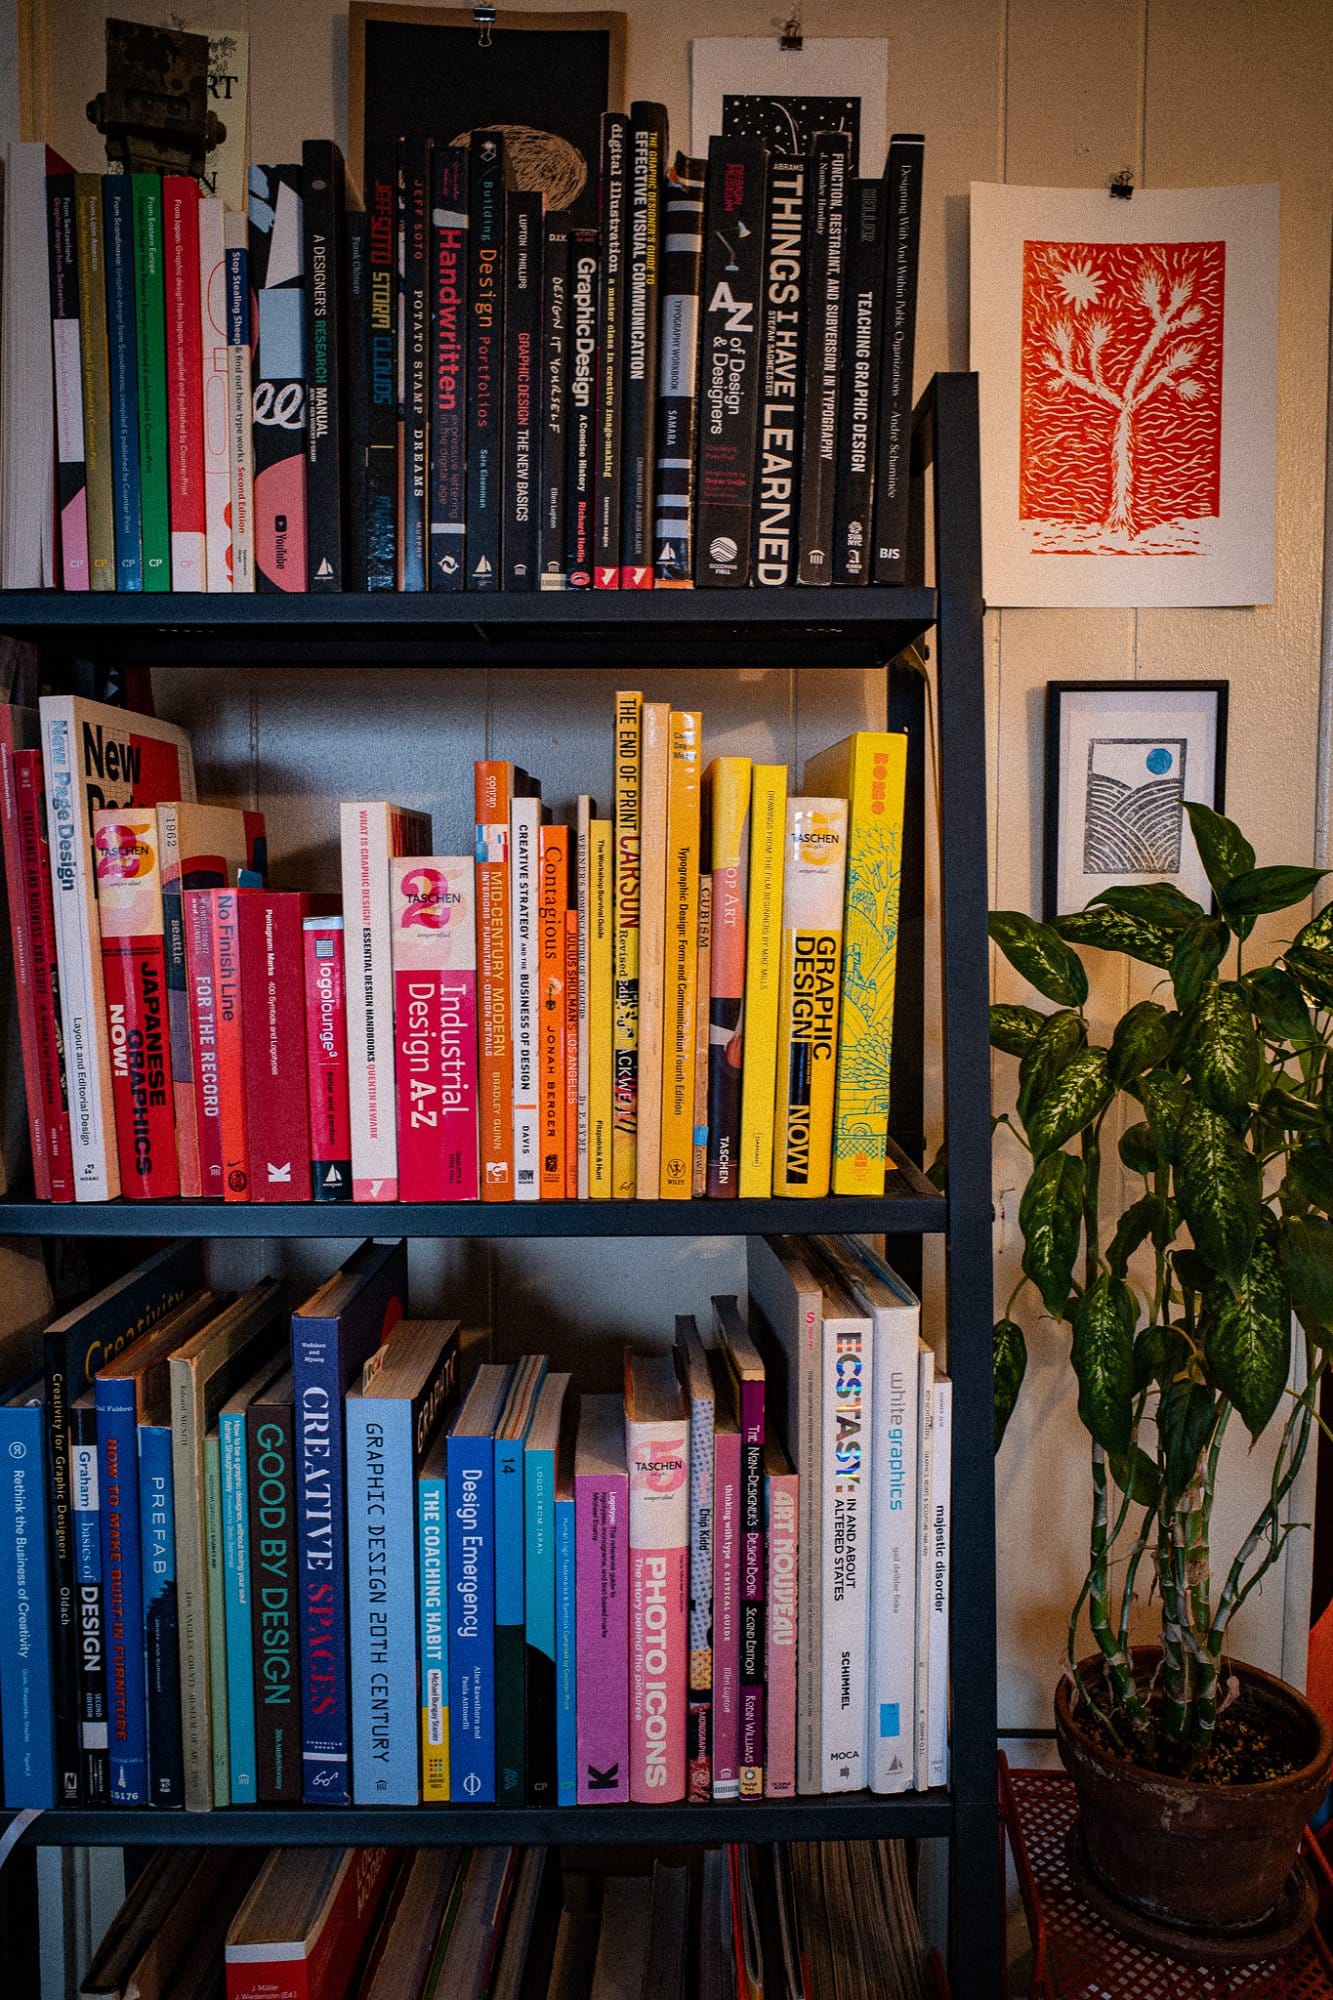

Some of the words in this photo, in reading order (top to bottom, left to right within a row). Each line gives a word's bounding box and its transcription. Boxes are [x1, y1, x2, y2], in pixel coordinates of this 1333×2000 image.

[634, 131, 648, 206] EFFECTIVE
[828, 153, 844, 210] FUNCTION,
[479, 181, 494, 241] Building
[633, 209, 646, 259] VISUAL
[229, 251, 240, 271] Stop
[313, 234, 325, 244] A
[768, 174, 803, 304] THINGS
[826, 213, 842, 274] RESTRAINT,
[230, 273, 241, 311] Stealing
[474, 248, 497, 328] Design
[826, 278, 840, 300] AND
[231, 312, 242, 345] Sheep
[414, 290, 423, 354] POTATO
[438, 229, 462, 410] Handwritten
[631, 262, 646, 380] COMMUNICATION
[777, 310, 795, 322] I
[824, 304, 839, 371] SUBVERSION
[855, 291, 872, 358] TEACHING
[235, 355, 244, 372] find
[314, 320, 327, 384] RESEARCH
[517, 332, 530, 384] GRAPHIC
[774, 330, 794, 397] HAVE
[236, 374, 244, 388] out
[236, 390, 245, 409] how
[414, 361, 423, 415] STAMP
[477, 336, 492, 428] Portfolios
[823, 375, 836, 386] IN
[853, 362, 870, 419] GRAPHIC
[235, 411, 245, 431] type
[315, 387, 328, 438] MANUAL
[517, 387, 530, 425] DESIGN
[820, 390, 836, 460] TYPOGRAPHY
[237, 433, 246, 463] works
[414, 429, 423, 498] DREAMS
[517, 430, 529, 452] THE
[578, 423, 587, 455] Concise
[851, 423, 868, 472] DESIGN
[238, 467, 246, 499] Second
[516, 455, 529, 480] NEW
[576, 457, 587, 492] History
[238, 501, 247, 533] Edition
[516, 482, 529, 521] BASICS
[578, 501, 587, 533] Richard
[757, 404, 795, 585] LEARNED
[275, 534, 287, 570] YouTube
[577, 535, 586, 563] Hollis
[879, 548, 900, 559] BIS
[619, 698, 637, 725] THE
[51, 720, 70, 768] New
[84, 722, 142, 785] New
[619, 730, 637, 760] END
[50, 771, 73, 820] Page
[619, 764, 637, 782] OF
[166, 817, 178, 847] 1962
[619, 790, 637, 832] PRINT
[53, 825, 78, 891] Design
[519, 824, 530, 877] CREATIVE
[675, 846, 689, 900] Typographic
[218, 895, 233, 921] No
[406, 894, 461, 903] TASCHEN
[520, 882, 530, 940] STRATEGY
[541, 846, 561, 959] Contagious
[699, 887, 711, 948] CUBISM
[171, 919, 185, 964] seattle
[491, 871, 505, 980] MID-CENTURY
[677, 939, 688, 961] Form
[219, 925, 235, 978] Finish
[677, 963, 687, 980] and
[196, 976, 213, 1009] FOR
[221, 984, 237, 1021] Line
[520, 973, 531, 1029] BUSINESS
[791, 936, 814, 1040] DESIGN
[814, 936, 835, 1060] GRAPHIC
[71, 1017, 85, 1048] Layout
[109, 1004, 129, 1077] NOW!
[141, 961, 166, 1106] JAPANESE
[198, 1014, 215, 1046] THE
[402, 982, 436, 1072] Design
[492, 988, 506, 1057] MODERN
[521, 1031, 531, 1046] OF
[675, 983, 687, 1052] Communication
[76, 1051, 86, 1069] and
[441, 984, 469, 1115] Industrial
[521, 1049, 531, 1091] DESIGN
[547, 1025, 556, 1075] JONAH
[675, 1054, 686, 1082] Fourth
[77, 1072, 89, 1112] Editorial
[128, 1030, 151, 1175] GRAPHICS
[200, 1052, 219, 1117] RECORD
[410, 1079, 437, 1128] A-Z
[674, 1084, 685, 1116] Edition
[78, 1113, 92, 1146] Design
[547, 1082, 556, 1137] BERGER
[522, 1125, 530, 1154] DAVIS
[719, 1136, 729, 1184] TASCHEN
[787, 1104, 810, 1175] NOW
[13, 1470, 27, 1510] Rethink
[79, 1451, 93, 1507] Graham
[257, 1423, 286, 1528] GOOD
[301, 1387, 333, 1570] CREATIVE
[366, 1423, 384, 1515] GRAPHIC
[502, 1458, 515, 1474] 14
[635, 1461, 682, 1471] TASCHEN
[423, 1490, 440, 1521] THE
[457, 1469, 482, 1529] Design
[697, 1508, 710, 1527] Chip
[722, 1484, 733, 1520] thinking
[845, 1498, 856, 1509] IN
[15, 1514, 27, 1534] the
[81, 1522, 96, 1563] basics
[151, 1477, 167, 1574] PREFAB
[699, 1529, 710, 1551] Kidd
[724, 1522, 733, 1539] with
[834, 1499, 845, 1554] ALTERED
[845, 1513, 856, 1539] AND
[932, 1505, 946, 1557] majestic
[16, 1537, 29, 1586] Business
[83, 1566, 97, 1582] of
[260, 1540, 287, 1577] BY
[368, 1525, 386, 1603] DESIGN
[423, 1525, 441, 1609] COACHING
[722, 1541, 733, 1560] type
[845, 1541, 856, 1589] ABOUT
[18, 1588, 30, 1600] of
[457, 1536, 482, 1637] Emergency
[834, 1558, 845, 1602] STATES
[934, 1561, 946, 1613] disorder
[15, 1603, 32, 1658] Creativity
[81, 1586, 102, 1671] DESIGN
[369, 1612, 387, 1663] 20TH
[425, 1613, 442, 1660] HABIT
[645, 1557, 667, 1674] PHOTO
[261, 1587, 290, 1704] DESIGN
[306, 1583, 337, 1715] SPACES
[841, 1651, 850, 1710] SCHIMMEL
[370, 1672, 389, 1763] CENTURY
[646, 1683, 667, 1788] ICONS
[830, 1751, 859, 1760] MOCA
